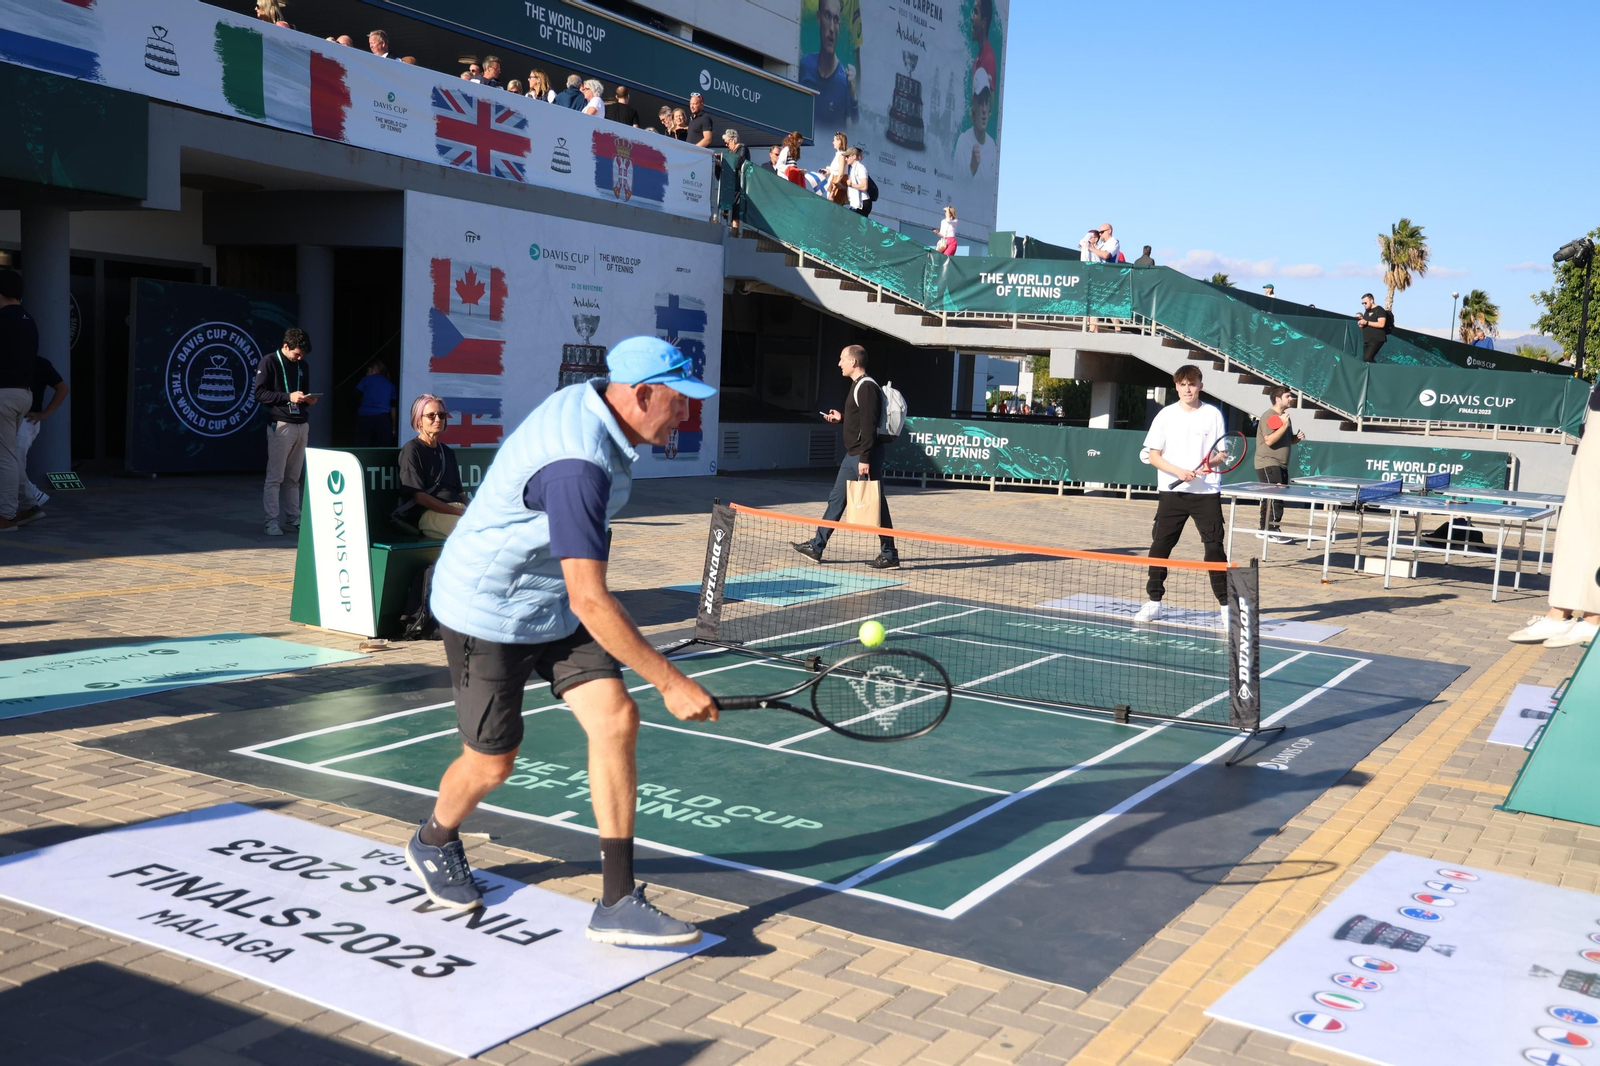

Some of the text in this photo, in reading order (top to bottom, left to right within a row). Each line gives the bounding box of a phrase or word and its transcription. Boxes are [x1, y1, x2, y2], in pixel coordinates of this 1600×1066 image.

[525, 2, 606, 42] THE WORLD CUP
[540, 24, 592, 54] OF TENNIS
[713, 77, 761, 104] DAVIS CUP
[374, 100, 407, 114] DAVIS CUP
[384, 118, 398, 126] WORLD
[542, 248, 589, 264] DAVIS CUP
[599, 253, 610, 261] THE
[611, 255, 629, 265] WORLD
[615, 265, 634, 274] TENNIS
[979, 272, 1080, 287] THE WORLD CUP
[996, 286, 1061, 298] OF TENNIS
[177, 329, 258, 366] DAVIS CUP FINALS
[1473, 359, 1496, 369] DAVIS CUP
[172, 373, 182, 396] THE
[177, 396, 206, 427] WORLD
[208, 419, 228, 430] CUP
[229, 412, 241, 425] OF
[1440, 394, 1514, 408] DAVIS CUP
[909, 432, 1008, 448] THE WORLD CUP
[925, 445, 990, 460] OF TENNIS
[1366, 459, 1463, 475] THE WORLD CUP
[1382, 472, 1424, 484] OF TEN
[333, 501, 351, 612] DAVIS CUP
[705, 542, 722, 614] DUNLOP
[1239, 597, 1250, 684] DUNLOP
[77, 652, 149, 666] DAVIS
[22, 664, 74, 675] CUP
[120, 670, 185, 683] DAVIS
[195, 662, 239, 672] CUP
[1291, 738, 1314, 749] CUP
[503, 774, 569, 791] OF
[512, 756, 569, 776] HE
[724, 805, 824, 830] CUP
[208, 838, 357, 880] 2023
[340, 874, 562, 946] FINALS
[107, 862, 322, 928] FINALS
[302, 922, 477, 978] 2023
[137, 909, 296, 964] MALAGA
